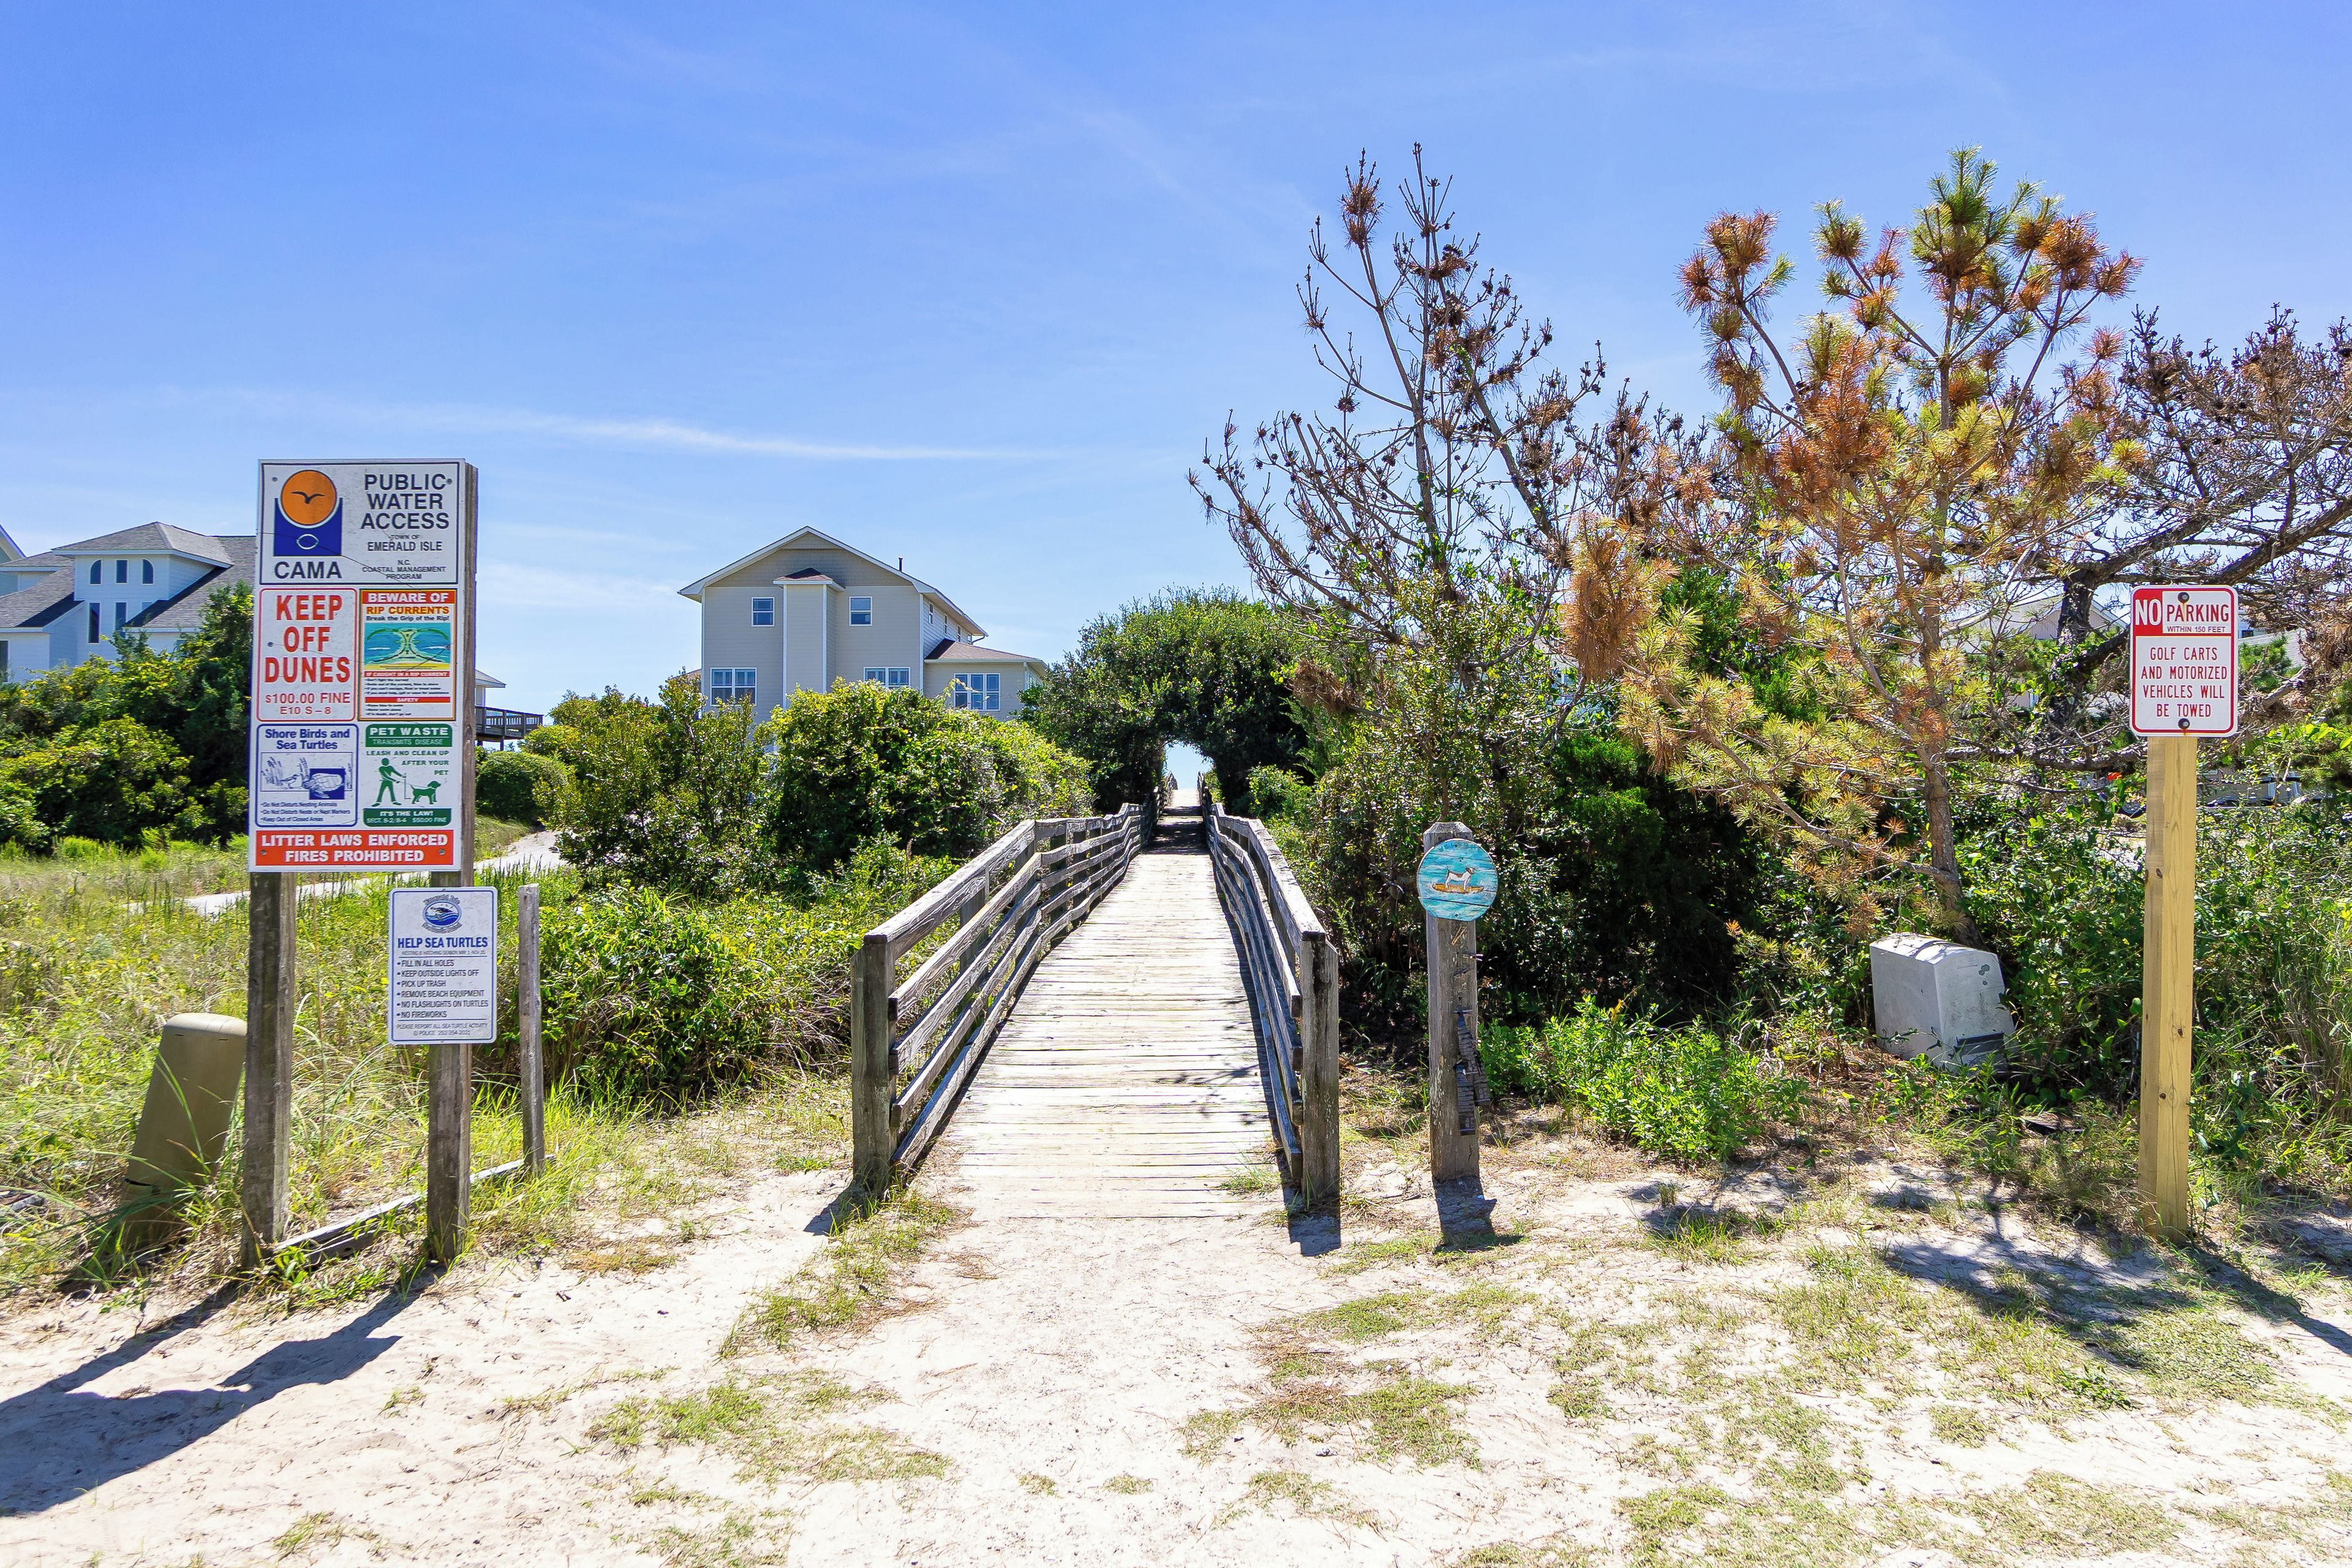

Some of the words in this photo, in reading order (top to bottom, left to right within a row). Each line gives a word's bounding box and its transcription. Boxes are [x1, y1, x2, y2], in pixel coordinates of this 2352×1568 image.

[364, 473, 447, 491] PUBLIC
[367, 493, 443, 510] WATER
[360, 512, 450, 529] ACCESS
[368, 541, 416, 551] EMERALD
[420, 541, 443, 551] ISLE
[274, 561, 343, 579] CAMA
[368, 593, 427, 603] BEWARE
[430, 592, 449, 603] OF
[276, 595, 343, 620] KEEP
[388, 606, 450, 614] CURRENTS
[2135, 598, 2162, 626] NO
[2166, 604, 2230, 622] PARKING
[284, 626, 331, 652] OFF
[2150, 647, 2177, 661] GOLF
[2184, 647, 2218, 661] CARTS
[265, 656, 351, 683] DUNES
[2141, 666, 2162, 680] AND
[2169, 666, 2228, 680] MOTORIZED
[2143, 685, 2193, 698] VEHICLES
[2200, 685, 2225, 698] WILL
[265, 693, 315, 704] $100.00
[320, 693, 351, 703] FINE
[280, 706, 301, 715] E10
[2157, 704, 2169, 717] BE
[2176, 704, 2211, 717] TOWED
[265, 728, 297, 739] Shore
[300, 728, 328, 739] Birds
[330, 728, 350, 738] and
[369, 727, 397, 736] PET
[399, 727, 449, 736] WASTE
[276, 740, 297, 750] Sea
[300, 739, 338, 750] Turtles
[261, 834, 315, 847] LITTER
[320, 834, 363, 846] LAWS
[368, 834, 448, 846] ENFORCED
[285, 850, 329, 862] FIRES
[334, 850, 425, 862] PROHIBITED
[398, 938, 423, 948] HELP
[424, 937, 445, 948] SEA
[446, 937, 488, 948] TURTLES
[449, 989, 484, 998] EQUIPMENT
